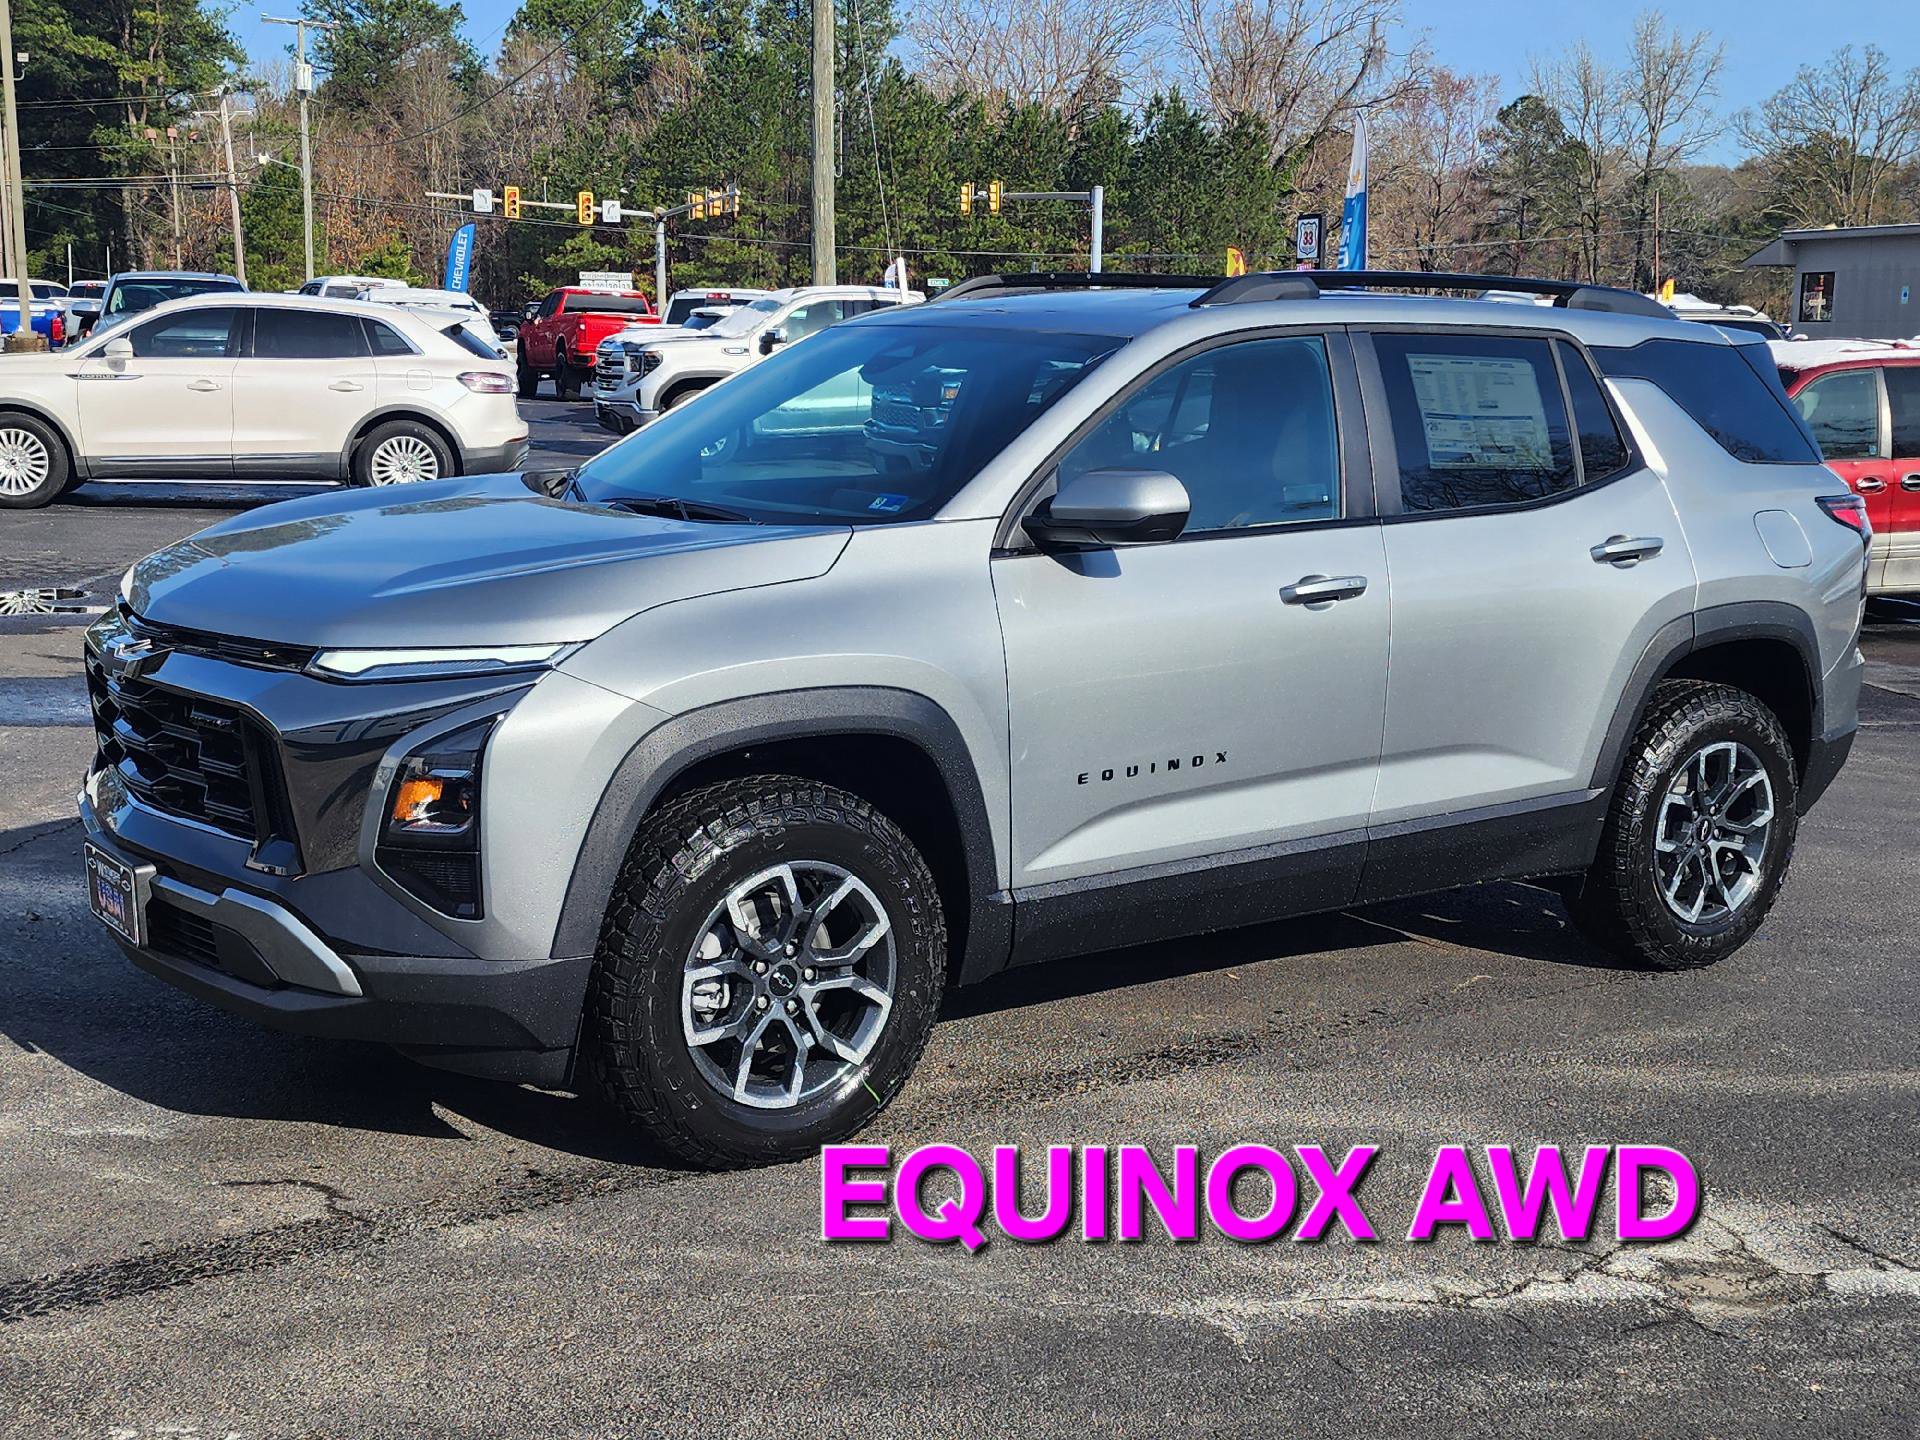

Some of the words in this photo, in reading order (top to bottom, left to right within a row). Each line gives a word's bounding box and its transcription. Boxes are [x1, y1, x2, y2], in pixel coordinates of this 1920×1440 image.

[1302, 230, 1314, 246] 33
[451, 230, 468, 289] CHEVROLET
[1077, 751, 1228, 785] EQUINOX
